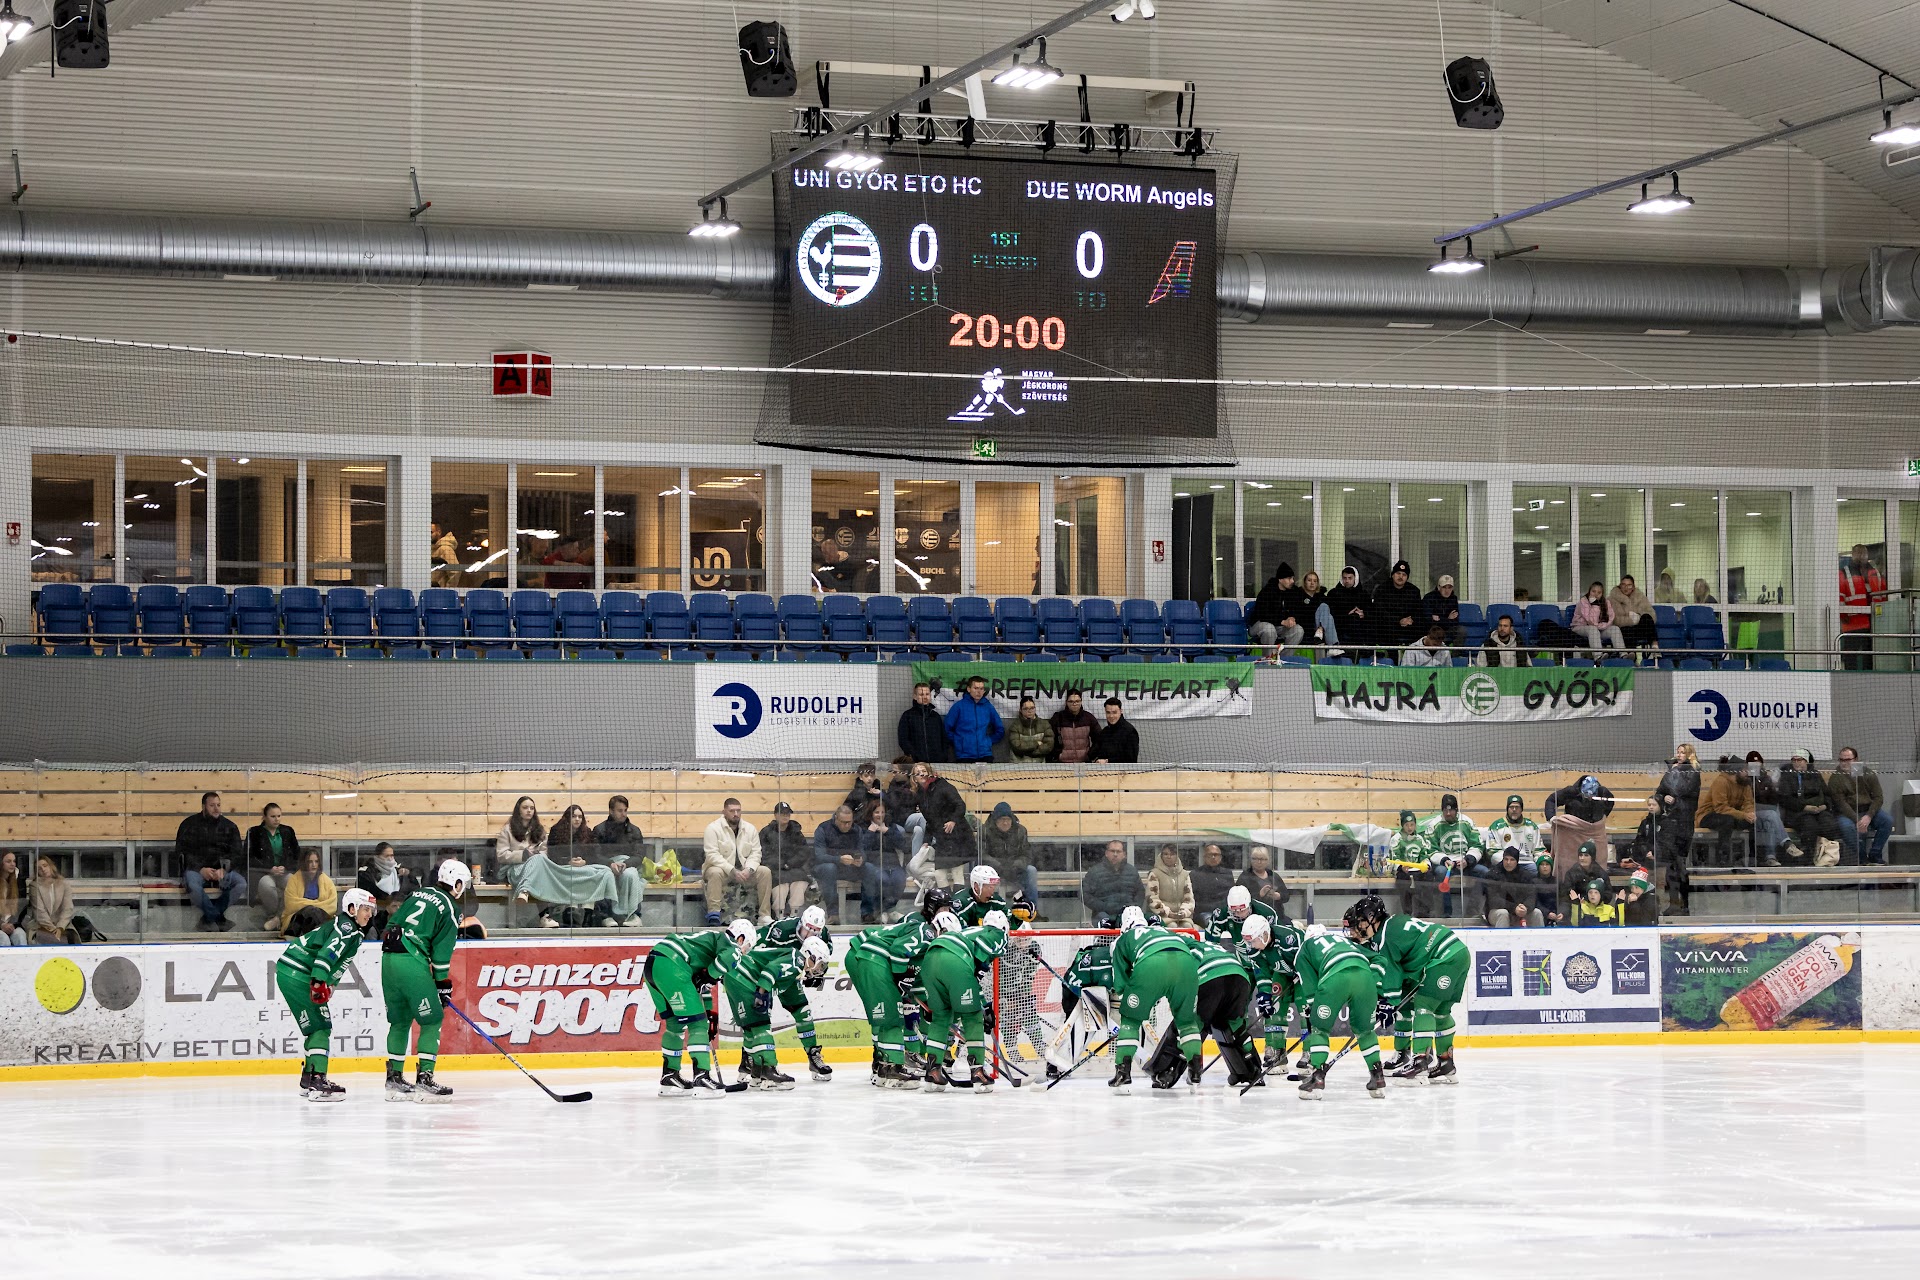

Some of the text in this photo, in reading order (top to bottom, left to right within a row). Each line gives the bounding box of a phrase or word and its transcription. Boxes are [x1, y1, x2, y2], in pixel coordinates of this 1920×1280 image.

[794, 167, 982, 195] UNI GYŐR ETO HC
[1026, 179, 1214, 210] DUE WORM Angels
[910, 223, 938, 271] 0
[990, 231, 1021, 248] 1ST
[1076, 230, 1104, 279] 0
[949, 312, 1067, 351] 20:00
[499, 358, 522, 387] A
[534, 359, 549, 388] A
[1021, 370, 1054, 378] MAGYAR
[1021, 380, 1068, 391] JÉGKORONG
[1021, 391, 1068, 402] SZÖVETSÉG
[1325, 671, 1441, 712] HAJRÁ
[1523, 670, 1618, 710] GYŐR!
[770, 696, 863, 714] RUDOLPH
[1738, 702, 1818, 719] RUDOLPH
[770, 717, 863, 726] LOGISTIK GRUPPE
[1738, 721, 1819, 730] LOGISTIK GRUPPE
[405, 900, 427, 926] 2
[327, 937, 346, 958] 21
[477, 954, 648, 987] nemzeti
[1481, 975, 1508, 984] VILL-KORR
[1616, 971, 1646, 980] VILL-KORR
[1675, 966, 1749, 974] VITAMINWATER
[1787, 967, 1808, 992] GEN
[1796, 961, 1810, 978] LA
[1805, 956, 1823, 980] COL
[165, 960, 373, 1002] LAA
[473, 983, 662, 1044] sport
[1540, 1010, 1586, 1023] VILL-KORR
[174, 1028, 375, 1058] BETONÉTŐ
[1054, 1023, 1072, 1047] CCM
